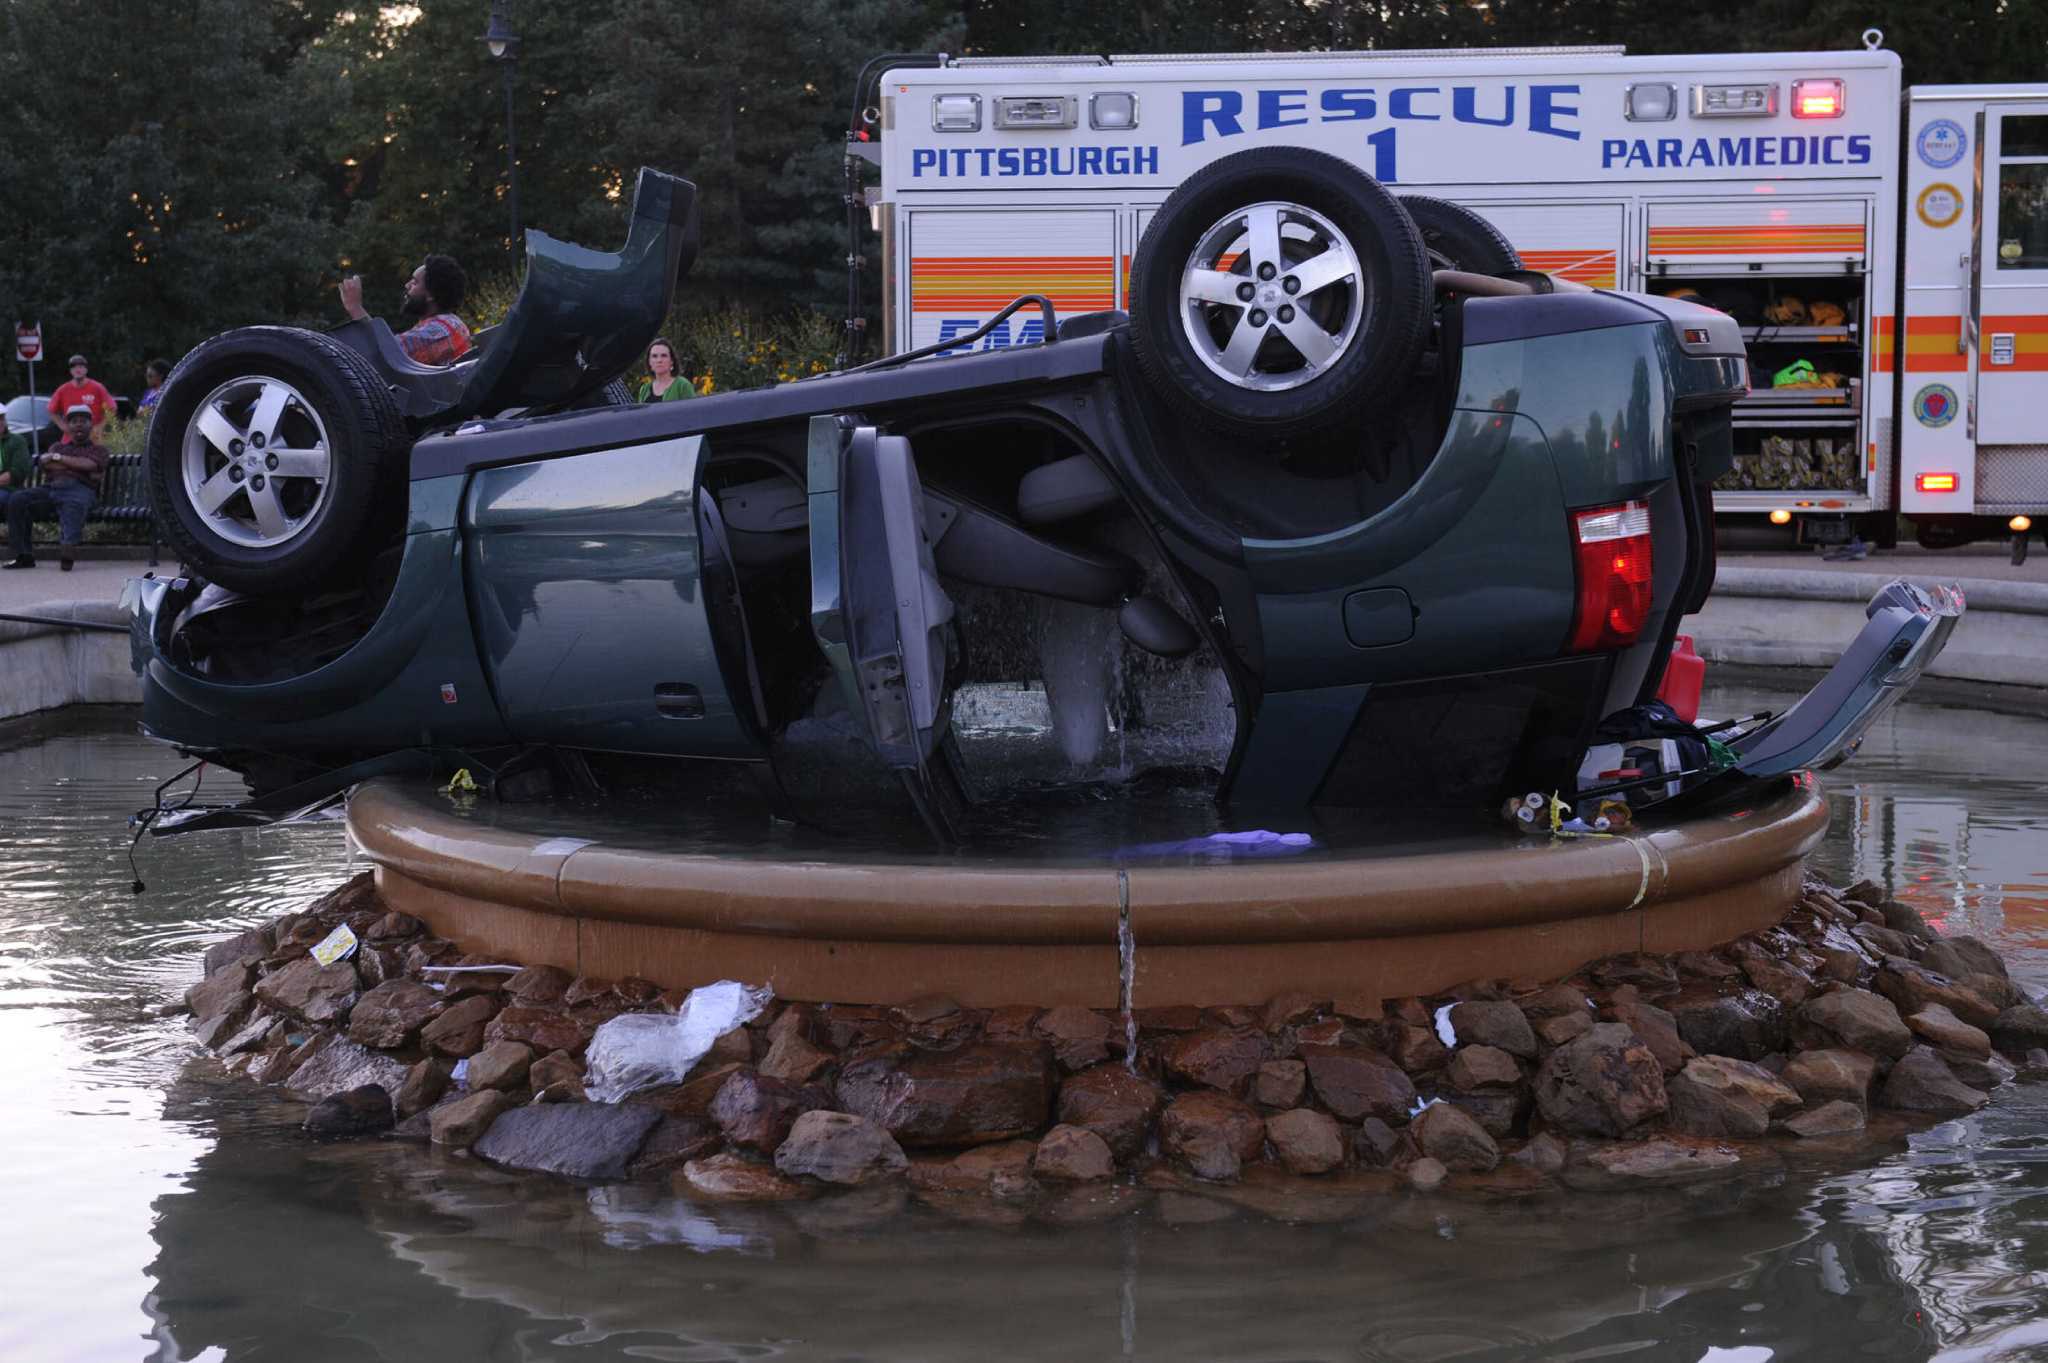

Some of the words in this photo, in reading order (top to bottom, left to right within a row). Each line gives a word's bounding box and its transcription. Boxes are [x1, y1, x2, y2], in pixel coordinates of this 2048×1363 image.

[1182, 84, 1581, 146] RESCUE
[912, 145, 1159, 178] PITTSBURGH
[1366, 126, 1398, 183] 1
[1602, 135, 1873, 169] PARAMEDICS
[934, 319, 1063, 358] EM
